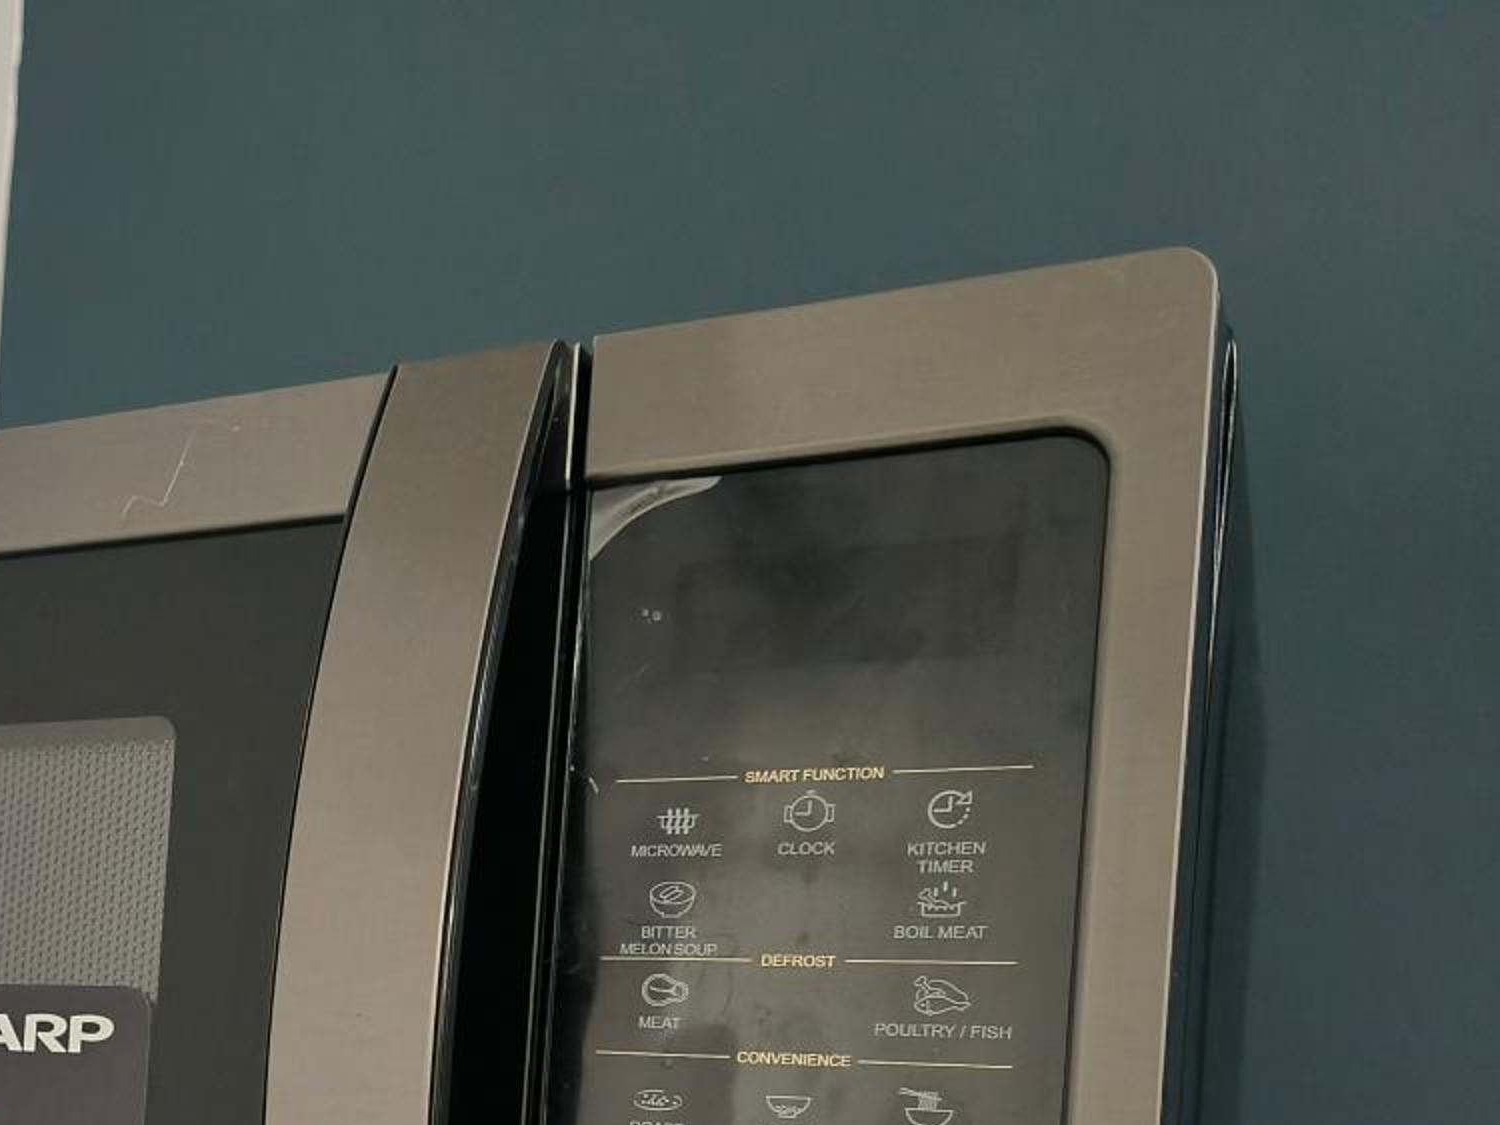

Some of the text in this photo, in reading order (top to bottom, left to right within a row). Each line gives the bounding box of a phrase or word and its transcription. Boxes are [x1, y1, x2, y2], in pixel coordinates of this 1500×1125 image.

[744, 766, 885, 784] SMART FUNCTION
[631, 843, 722, 858] MICROWAVE
[777, 841, 836, 856] CLOCK
[907, 841, 986, 856] KITCHEN
[917, 859, 974, 874] TIMER
[641, 925, 697, 939] BITTER
[893, 925, 988, 940] BOIL MEAT
[620, 943, 718, 957] MELON SOUP
[760, 953, 836, 969] DEFROST
[638, 1015, 681, 1029] MEAT
[874, 1022, 955, 1038] POULTRY
[969, 1026, 1013, 1040] FISH
[736, 1051, 852, 1068] CONVENIENCE
